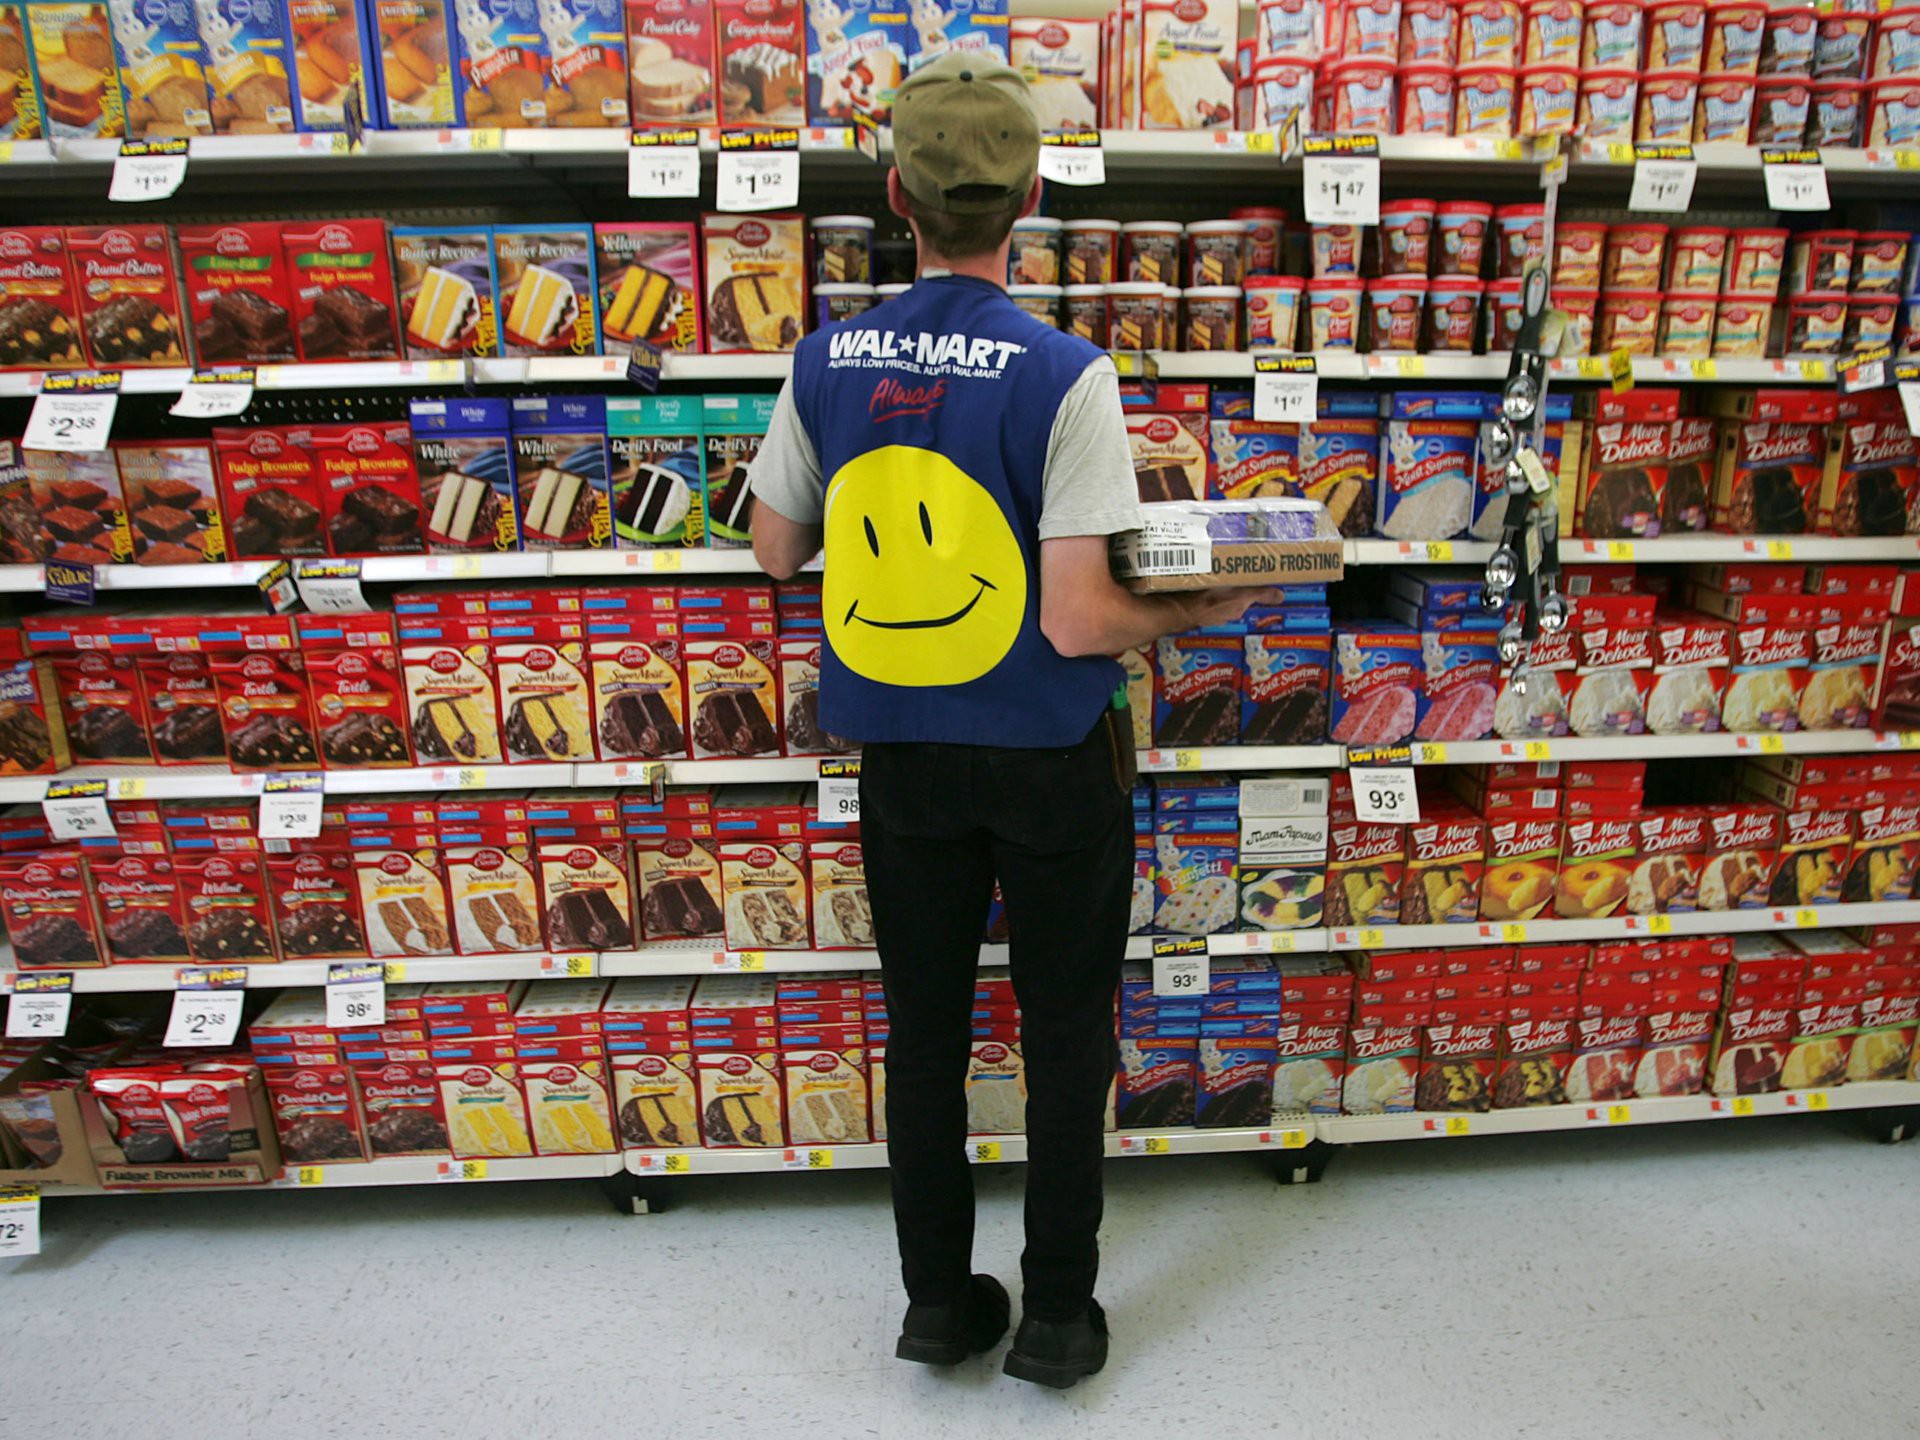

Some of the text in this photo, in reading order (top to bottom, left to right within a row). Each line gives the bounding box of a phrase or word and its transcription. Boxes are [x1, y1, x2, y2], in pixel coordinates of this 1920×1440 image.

[642, 17, 702, 36] Pound Cake
[470, 49, 521, 85] Pumpkin
[551, 48, 603, 85] Pumpkin
[632, 133, 659, 146] Low
[721, 130, 799, 148] Low Prices
[1304, 135, 1376, 152] Low Prices
[399, 243, 436, 260] Butter
[128, 262, 164, 278] Butter
[828, 358, 861, 369] ALWAYS
[862, 359, 884, 369] LOW
[1256, 358, 1279, 370] Low
[44, 375, 76, 390] Low
[1628, 424, 1667, 440] Moist
[420, 441, 462, 460] White
[518, 438, 557, 456] White
[611, 437, 683, 455] Devil's Food
[708, 437, 747, 454] Devil's
[1601, 439, 1666, 465] Deluxe
[228, 459, 311, 477] Fudge Brownies
[325, 459, 356, 475] Fudge
[1280, 553, 1340, 571] FROSTING
[1611, 628, 1648, 645] Moist
[1689, 627, 1725, 645] Moist
[1768, 626, 1805, 645] Moist
[1846, 622, 1880, 642] Moist
[1586, 641, 1650, 666] Deluxe
[1663, 640, 1726, 665] Deluxe
[1742, 640, 1806, 665] Deluxe
[1819, 637, 1881, 663] Deluxe
[243, 681, 279, 697] Turtle
[336, 679, 371, 695] Turtle
[1348, 746, 1411, 764] Low Prices
[820, 763, 860, 777] Low Pri
[1670, 816, 1704, 835] Moist
[1740, 812, 1774, 831] Moist
[1816, 810, 1849, 829] Moist
[1363, 825, 1401, 843] Moist
[1443, 823, 1480, 843] Moist
[1523, 822, 1556, 840] Moist
[1596, 820, 1633, 839] Moist
[1714, 823, 1776, 849] Deluxe
[1790, 821, 1851, 847] Deluxe
[1336, 836, 1400, 861] Deluxe
[1416, 835, 1481, 860] Deluxe
[1494, 834, 1558, 858] Deluxe
[1572, 831, 1634, 857] Deluxe
[1644, 828, 1704, 852] Deluxe
[1153, 940, 1206, 956] Low Prices
[1675, 1011, 1709, 1029] Moist
[1755, 1008, 1788, 1025] Moist
[1824, 1004, 1855, 1021] Moist
[1302, 1024, 1341, 1041] Moist
[1378, 1024, 1415, 1041] Moist
[1455, 1023, 1493, 1041] Moist
[1534, 1019, 1569, 1036] Moist
[1605, 1015, 1638, 1033] Moist
[1731, 1019, 1790, 1041] Deluxe
[1798, 1015, 1857, 1038] Deluxe
[1510, 1029, 1569, 1052] Deluxe
[1581, 1026, 1639, 1049] Deluxe
[1650, 1022, 1709, 1045] Deluxe
[1278, 1036, 1342, 1057] Deluxe
[1356, 1035, 1418, 1058] Deluxe
[1432, 1033, 1494, 1056] Deluxe
[106, 1168, 244, 1182] Fudge Brownie Mix
